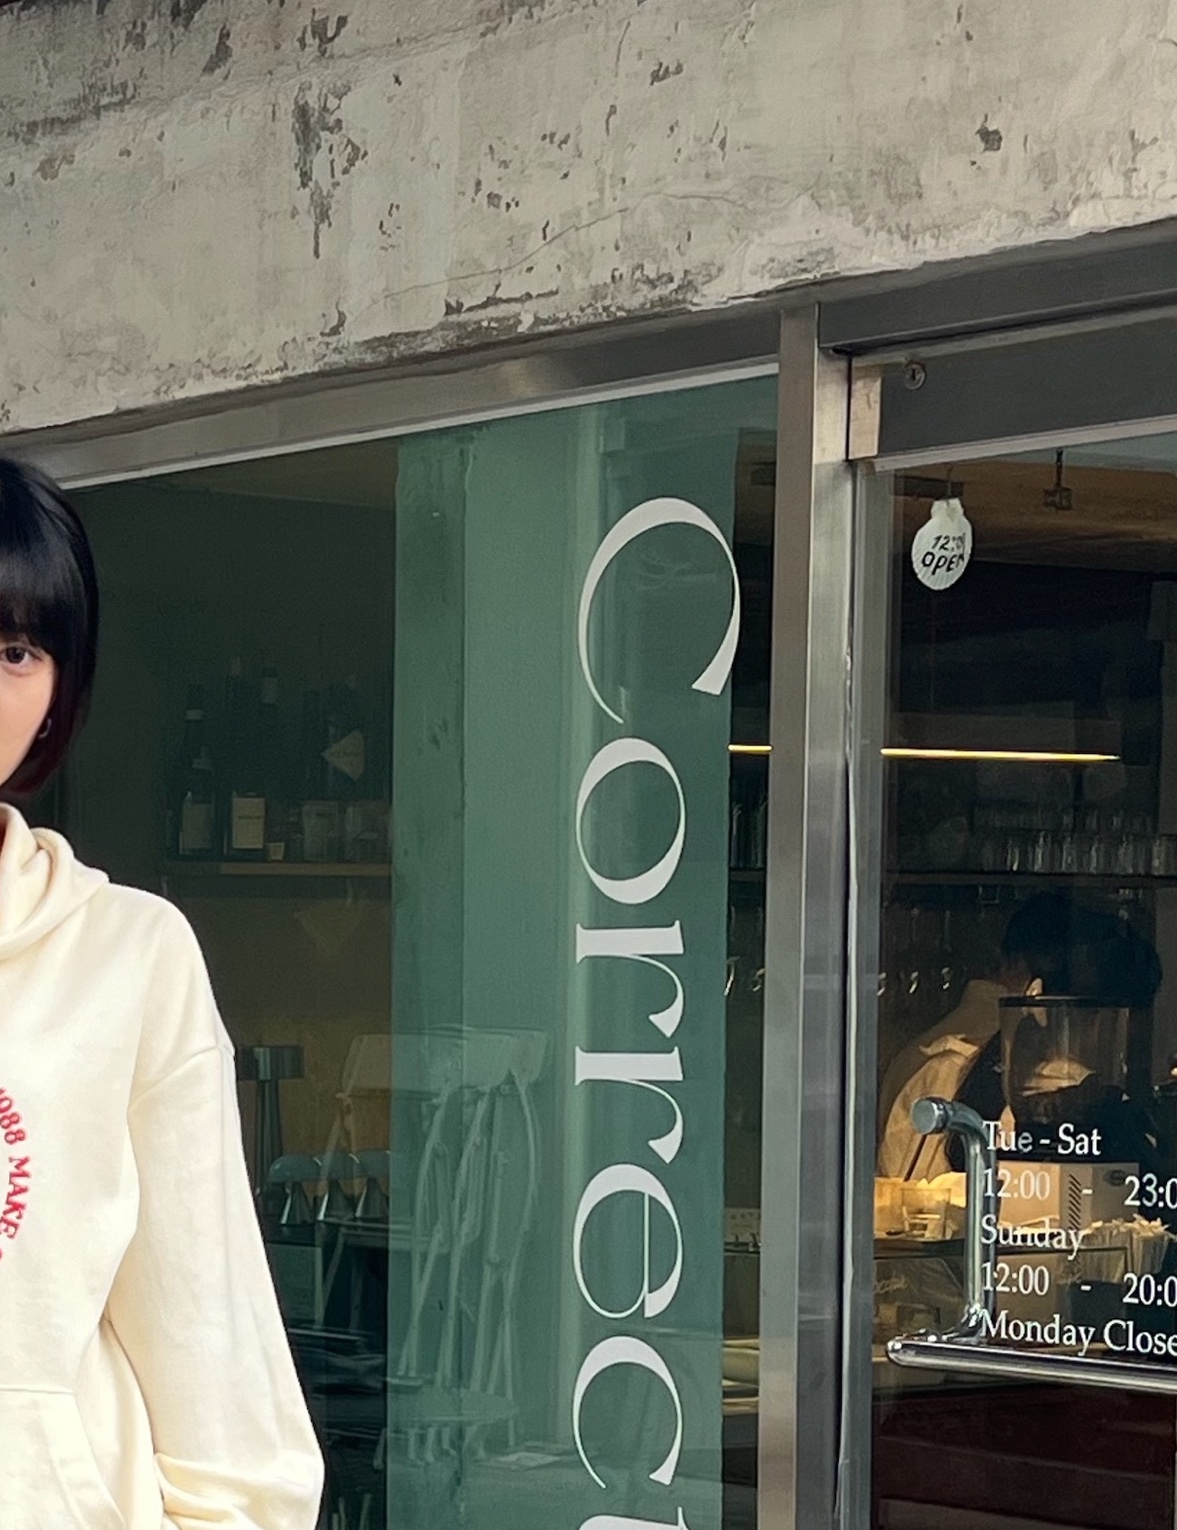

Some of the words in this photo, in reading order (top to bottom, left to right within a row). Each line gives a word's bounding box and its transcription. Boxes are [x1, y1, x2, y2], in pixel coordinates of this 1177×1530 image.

[982, 1120, 1033, 1152] Tue
[1057, 1123, 1102, 1155] Sat
[982, 1168, 1051, 1200] 12:00
[981, 1213, 1085, 1260] Sunday
[981, 1262, 1050, 1295] 12:00
[981, 1310, 1095, 1356] Monday
